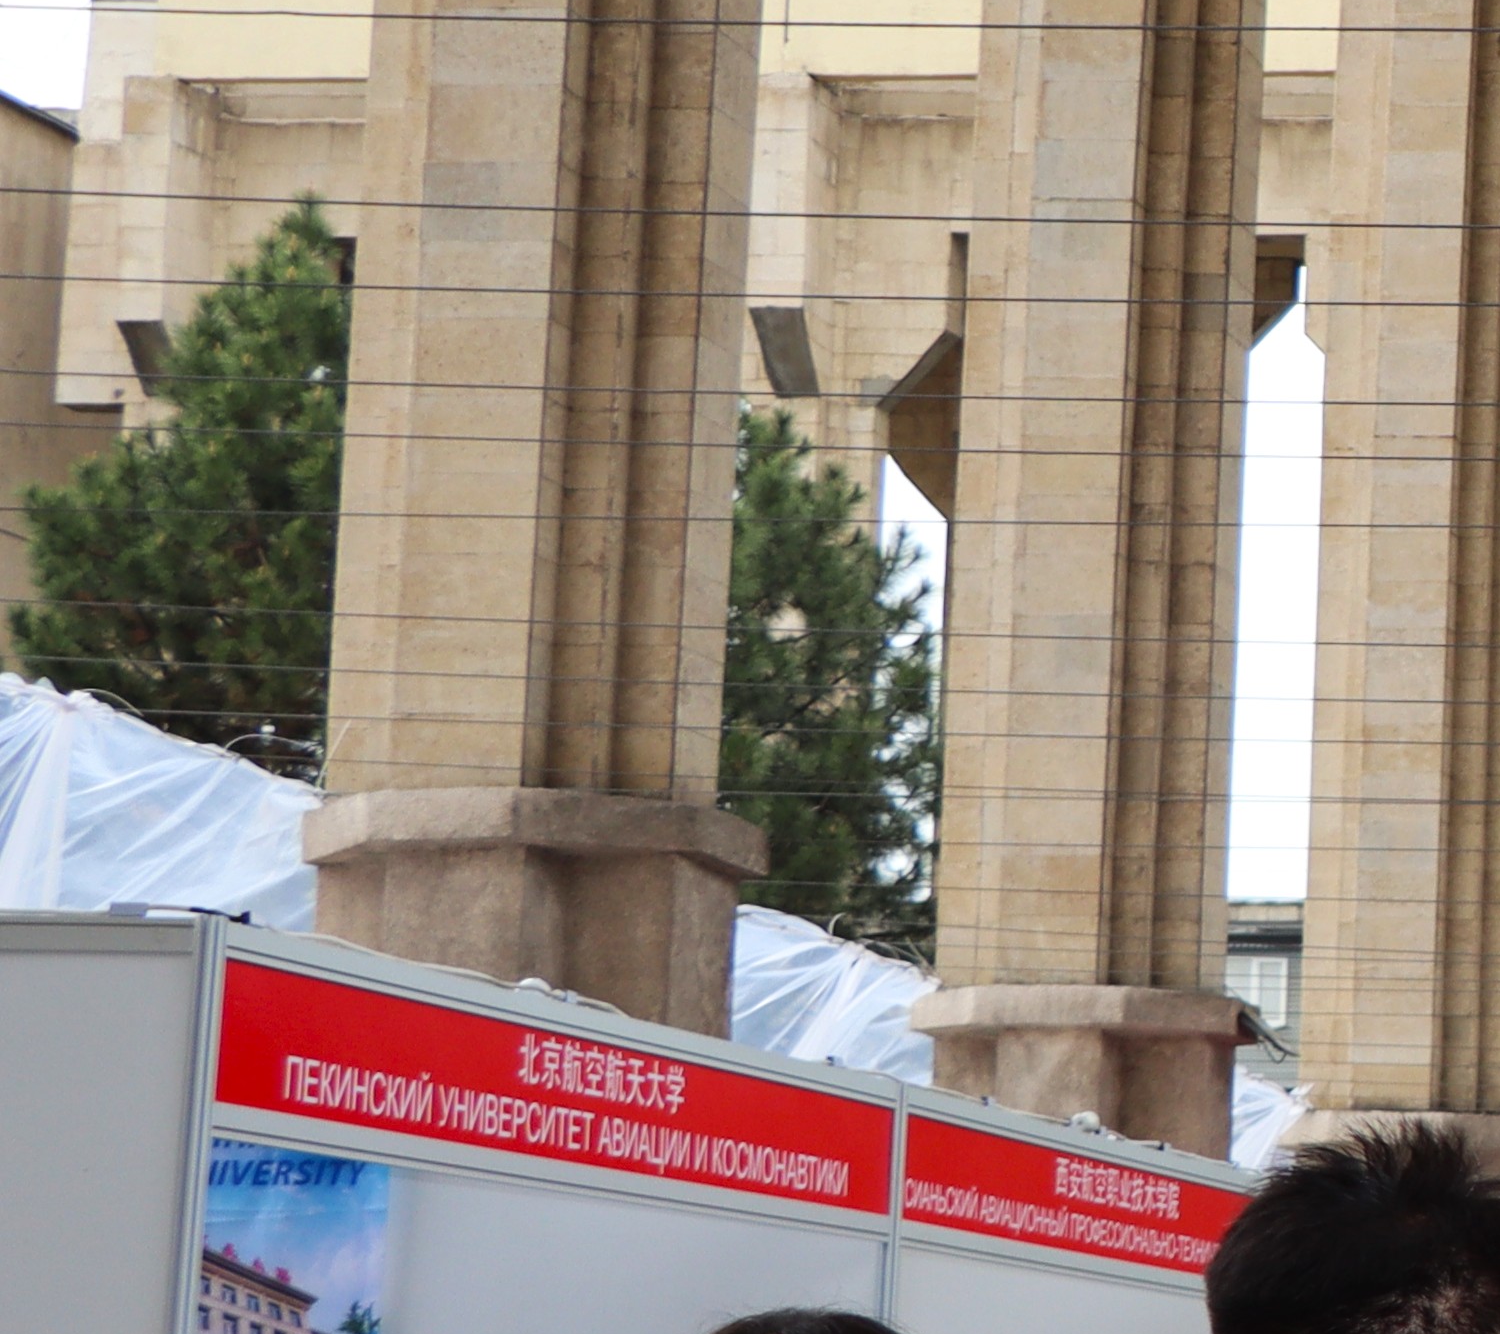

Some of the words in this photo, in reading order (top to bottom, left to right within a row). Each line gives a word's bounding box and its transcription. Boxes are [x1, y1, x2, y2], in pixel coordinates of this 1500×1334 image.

[518, 1032, 686, 1115] 北京航空航天大学
[283, 1054, 433, 1125] ПЕКИНСКИЙ
[438, 1082, 596, 1151] УНИВЕРСИТЕТ
[597, 1114, 692, 1176] АВИАЦИИ
[694, 1132, 709, 1174] И
[712, 1135, 850, 1198] КОСМОНАВТИКИ
[904, 1177, 979, 1219] СИАНЬСКИЙ
